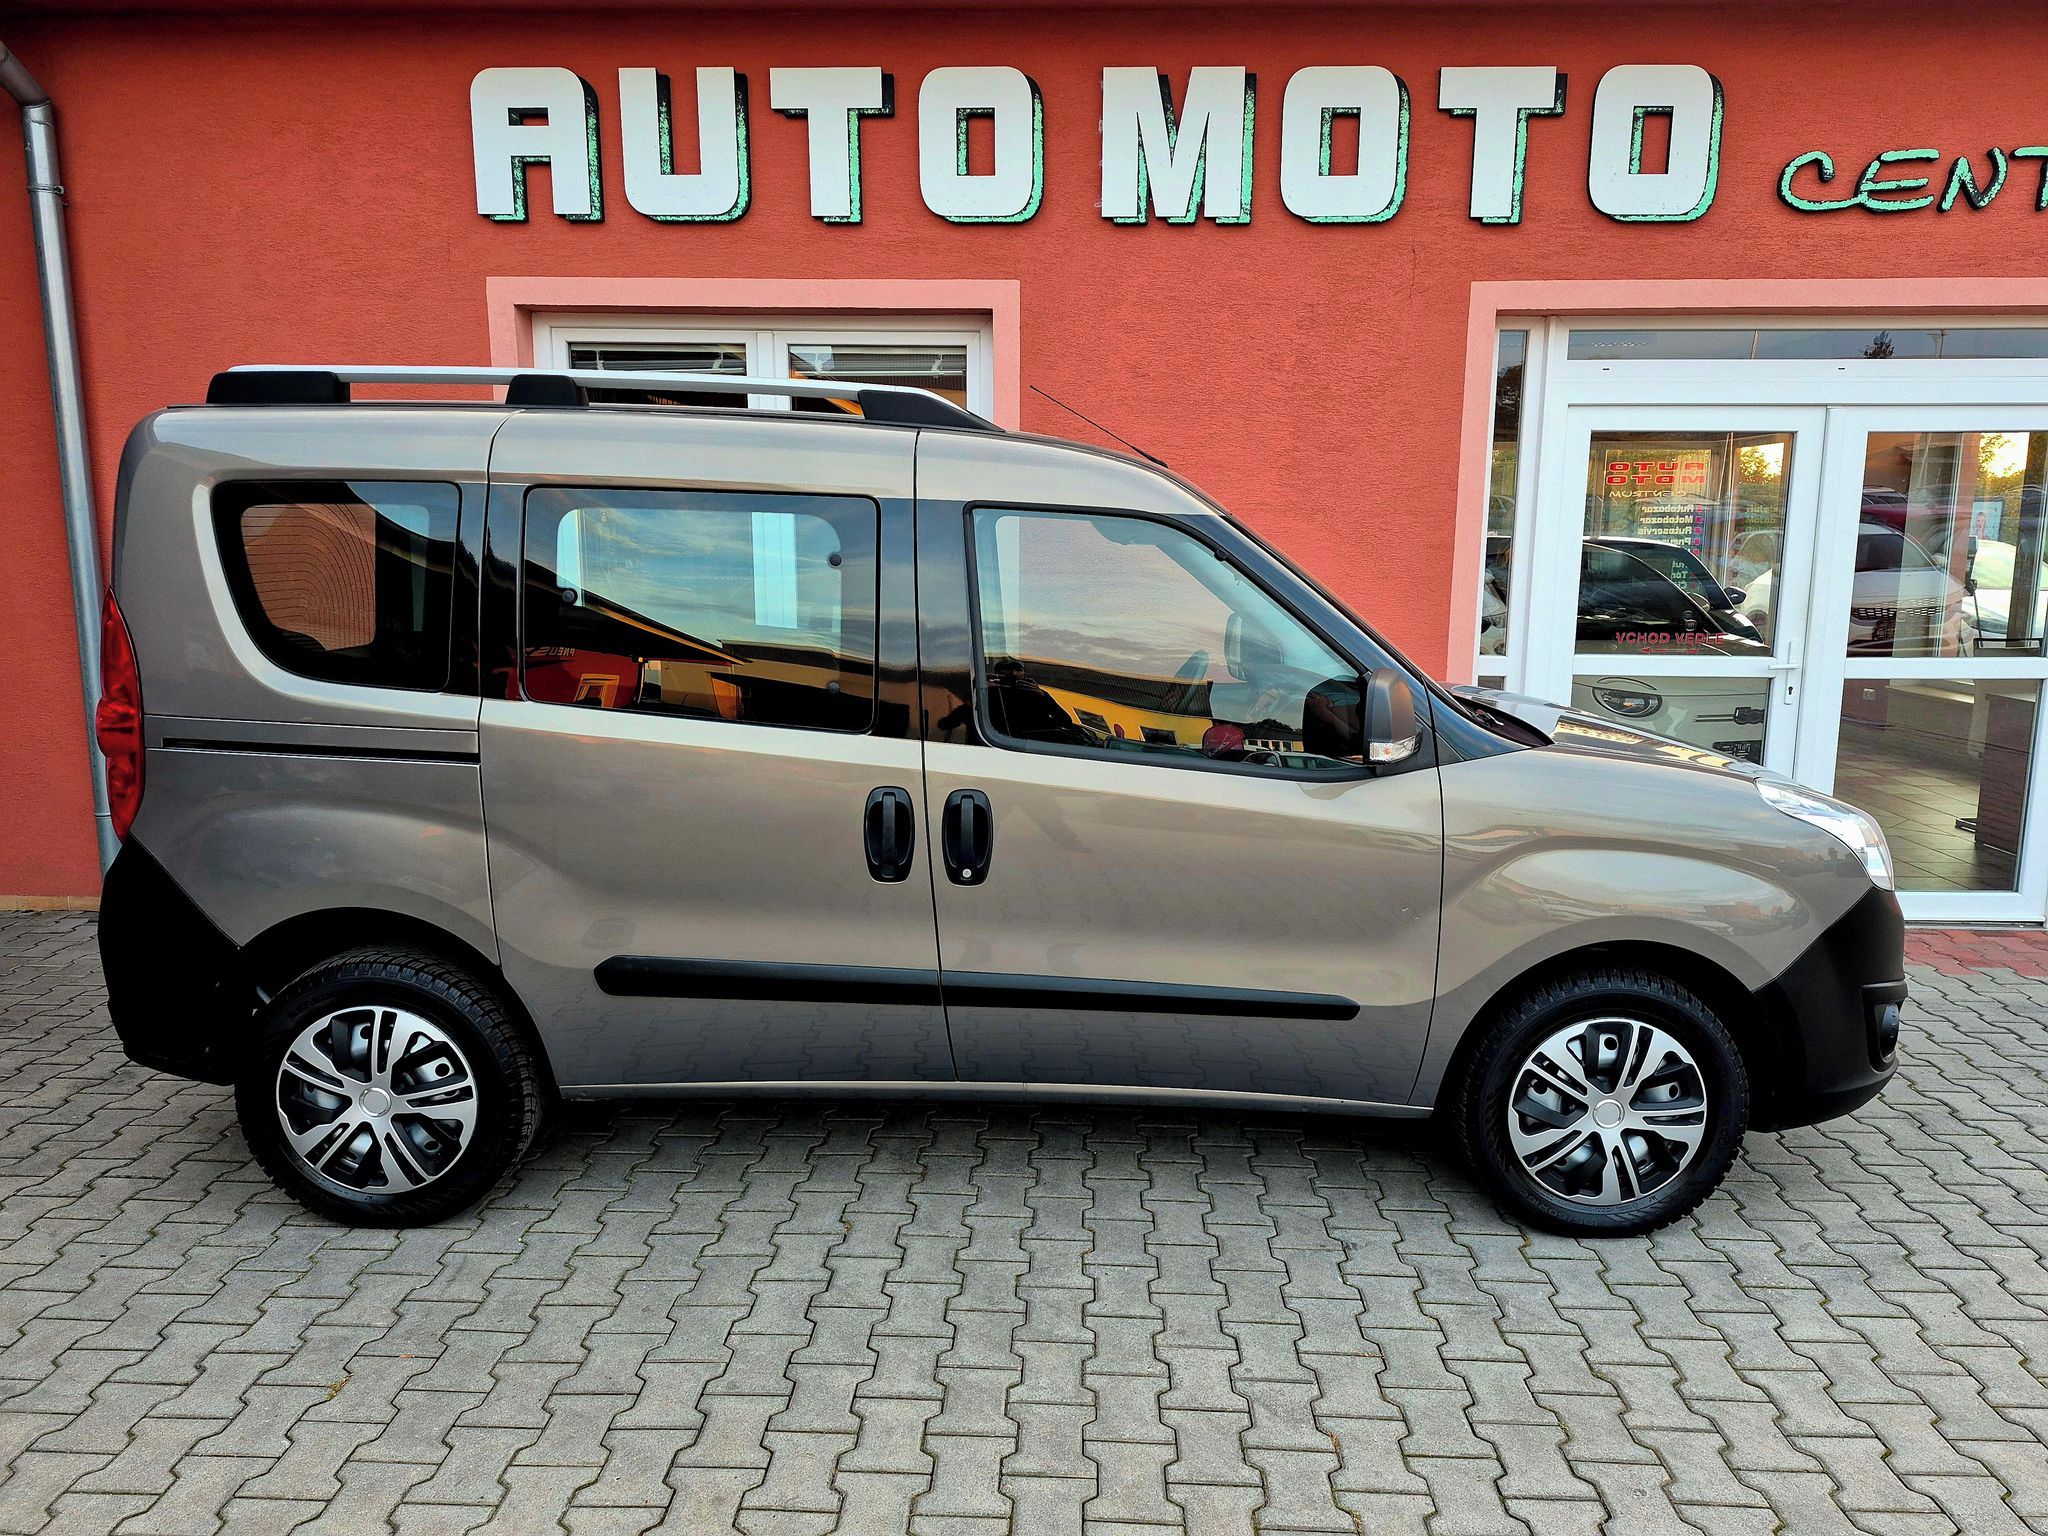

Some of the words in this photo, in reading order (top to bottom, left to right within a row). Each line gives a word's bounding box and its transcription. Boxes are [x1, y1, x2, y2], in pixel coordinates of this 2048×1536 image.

[469, 66, 1046, 223] AUTO
[1101, 64, 1725, 224] MOTO
[1615, 632, 1671, 644] VCHOD
[1675, 632, 1727, 646] VEDLE
